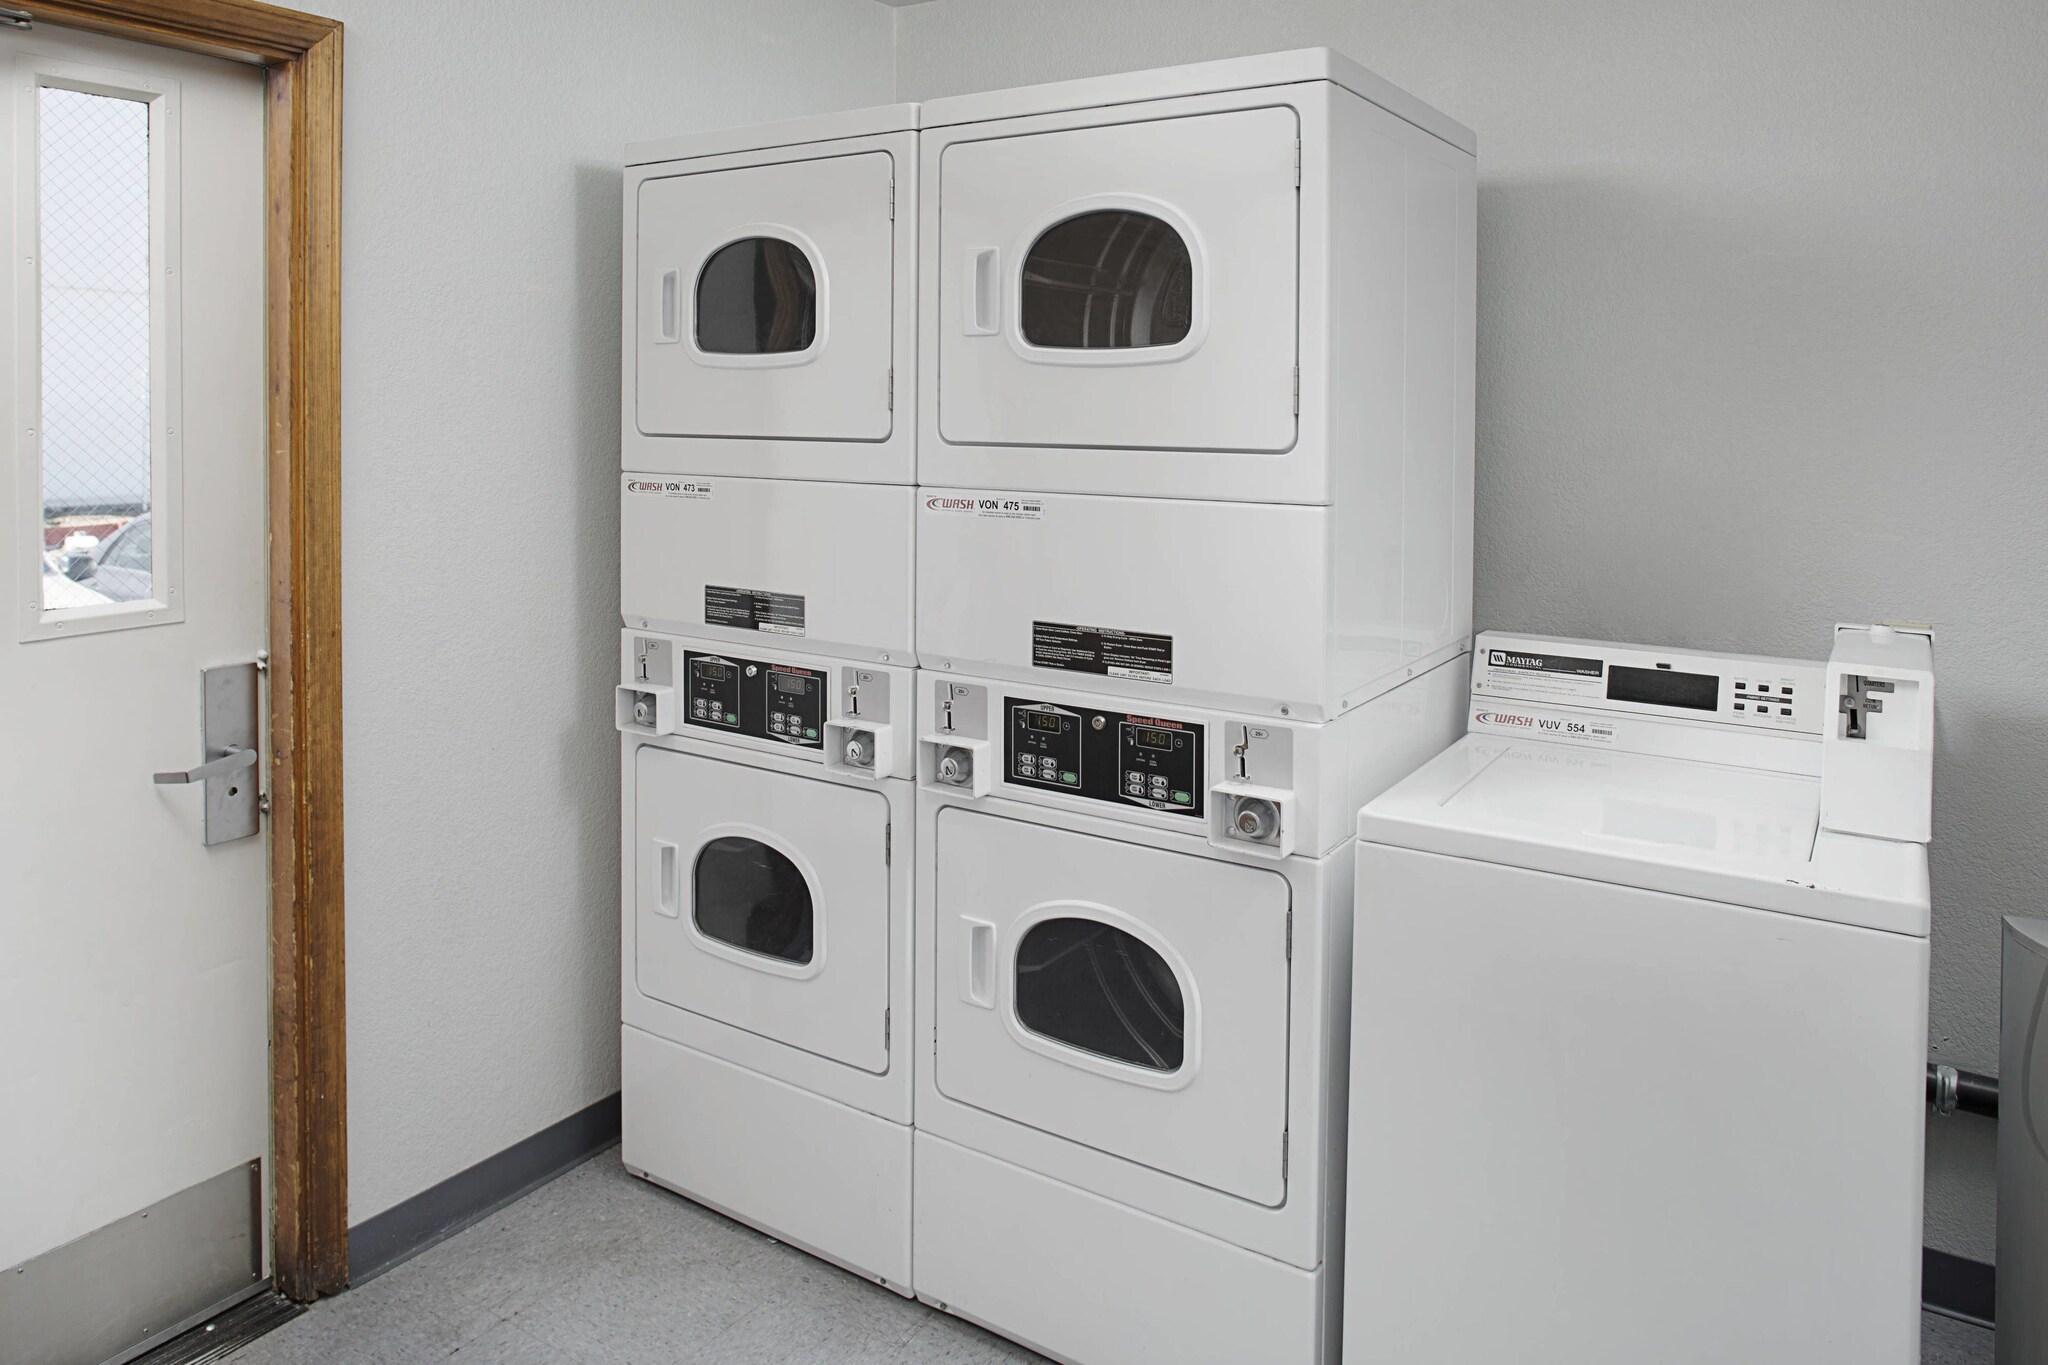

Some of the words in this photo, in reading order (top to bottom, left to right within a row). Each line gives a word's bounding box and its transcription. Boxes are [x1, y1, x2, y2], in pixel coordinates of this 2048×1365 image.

[639, 482, 663, 492] WASH
[665, 482, 681, 491] VON
[683, 484, 696, 492] 473
[942, 498, 975, 510] WASH
[979, 499, 999, 510] VON
[1003, 501, 1020, 511] 475
[1506, 655, 1543, 667] MAYTAG
[1040, 704, 1055, 712] UPPER
[1126, 714, 1154, 726] Speed
[1154, 719, 1184, 730] Queen
[1494, 713, 1534, 727] WASH
[1538, 719, 1561, 730] VUV
[1567, 722, 1585, 733] 554
[1144, 731, 1167, 745] 150
[1148, 800, 1167, 809] LOWER
